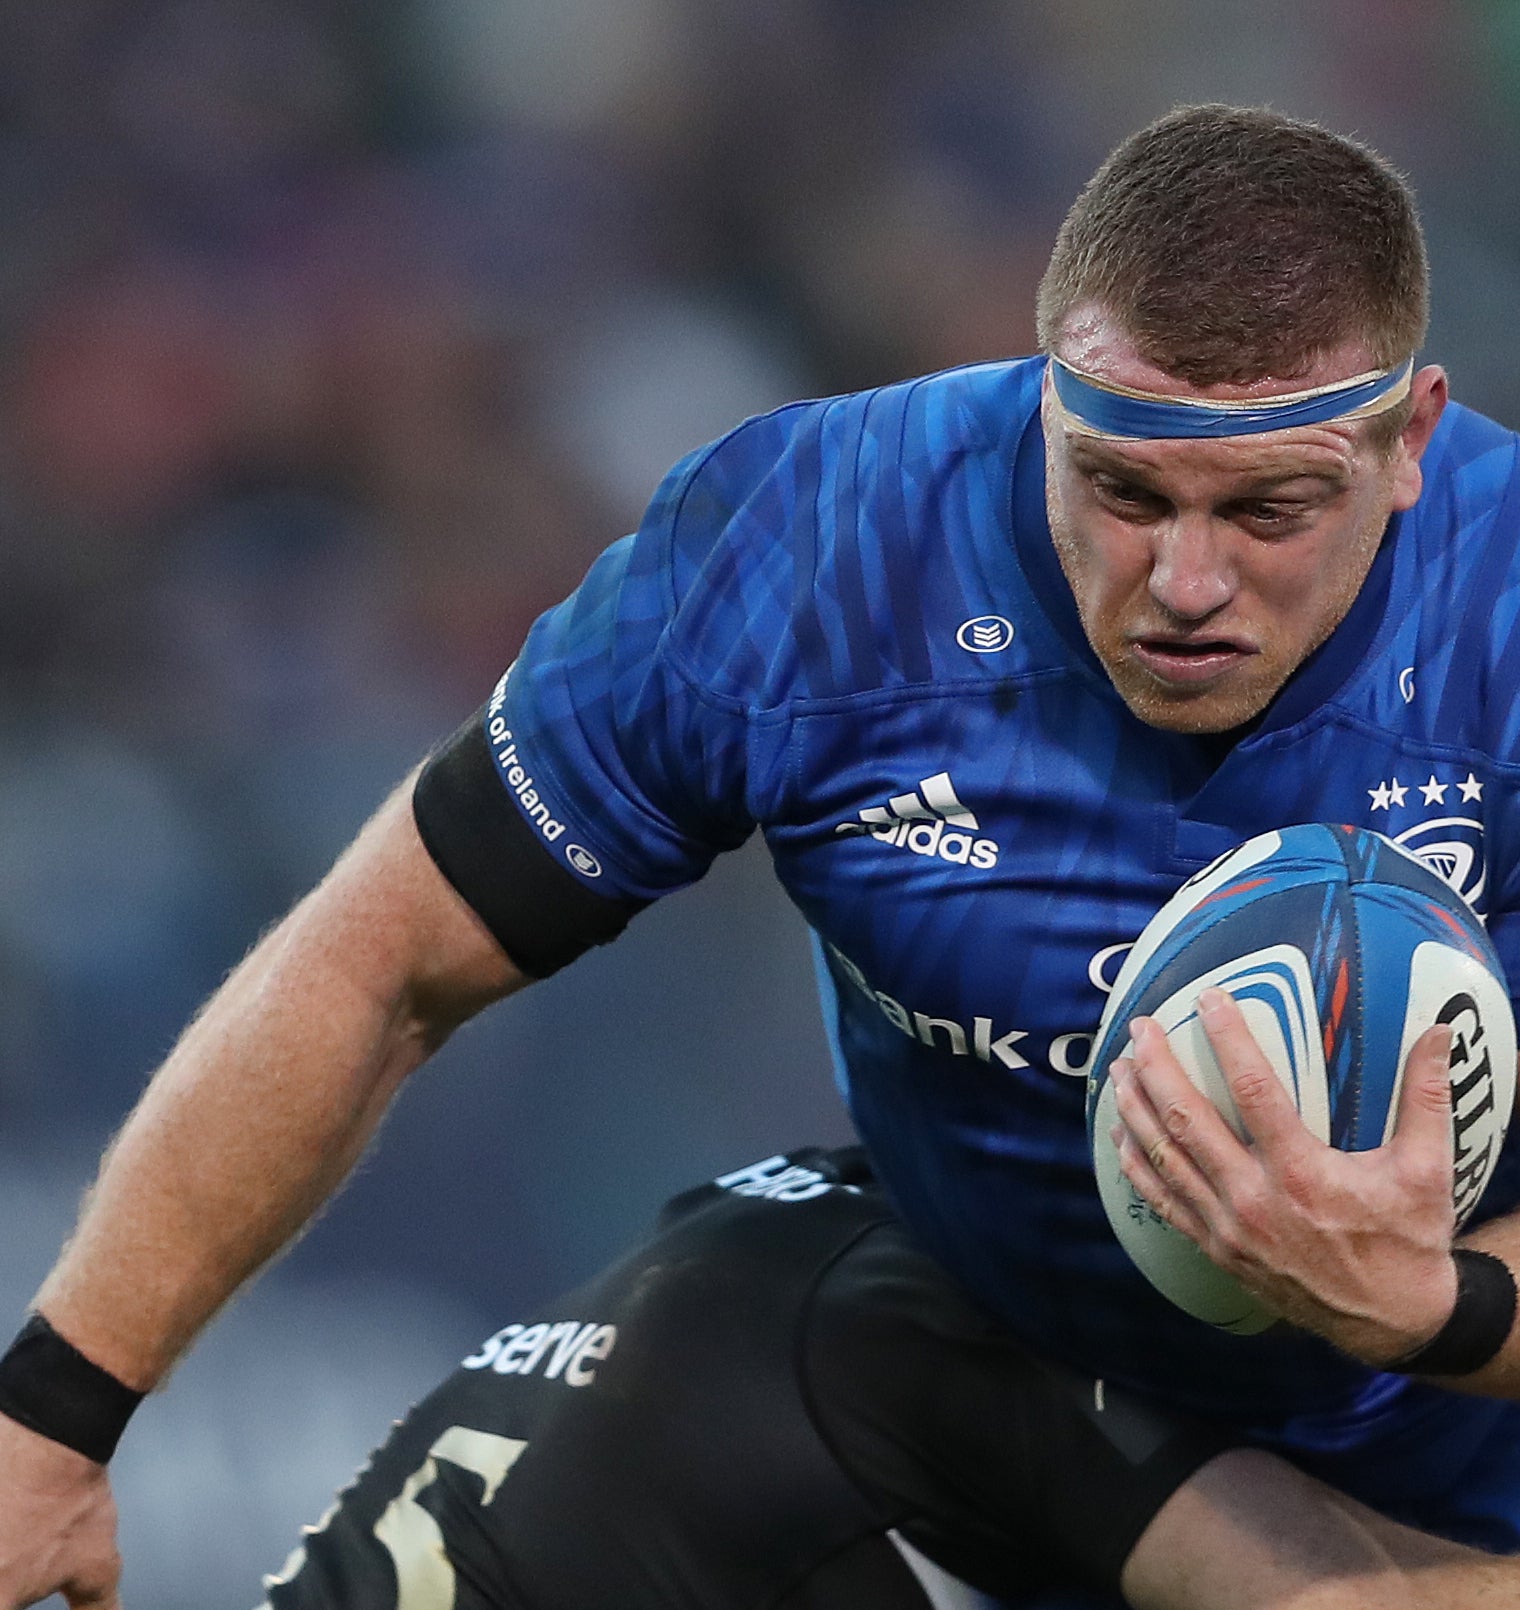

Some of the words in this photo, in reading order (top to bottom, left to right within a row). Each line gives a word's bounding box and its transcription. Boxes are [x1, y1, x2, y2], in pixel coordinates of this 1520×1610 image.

[490, 716, 513, 745] of
[499, 744, 566, 842] Ireland
[825, 941, 1030, 1070] ank
[1048, 1032, 1097, 1077] o
[461, 1320, 618, 1387] serve
